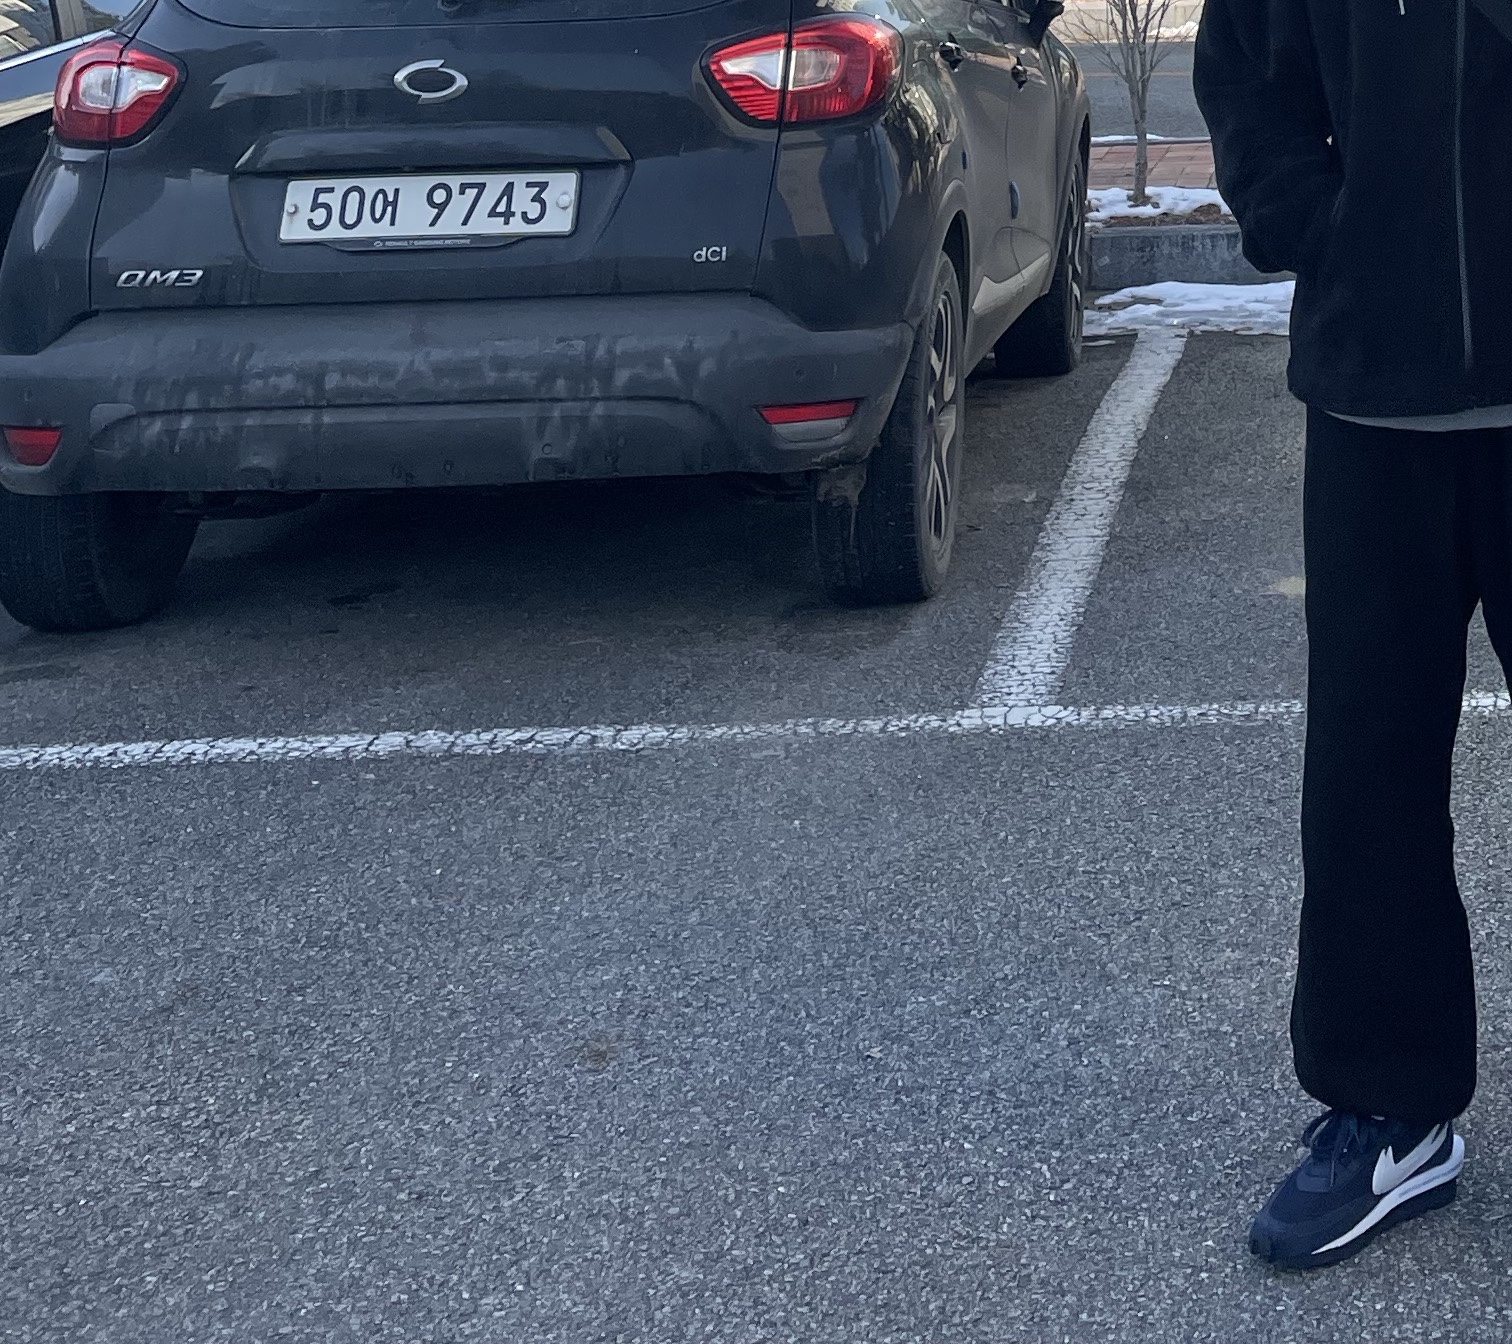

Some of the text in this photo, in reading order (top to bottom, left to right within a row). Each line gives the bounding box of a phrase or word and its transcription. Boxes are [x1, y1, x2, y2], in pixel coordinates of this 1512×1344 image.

[307, 180, 549, 231] 50어 9743
[116, 269, 204, 287] QM3
